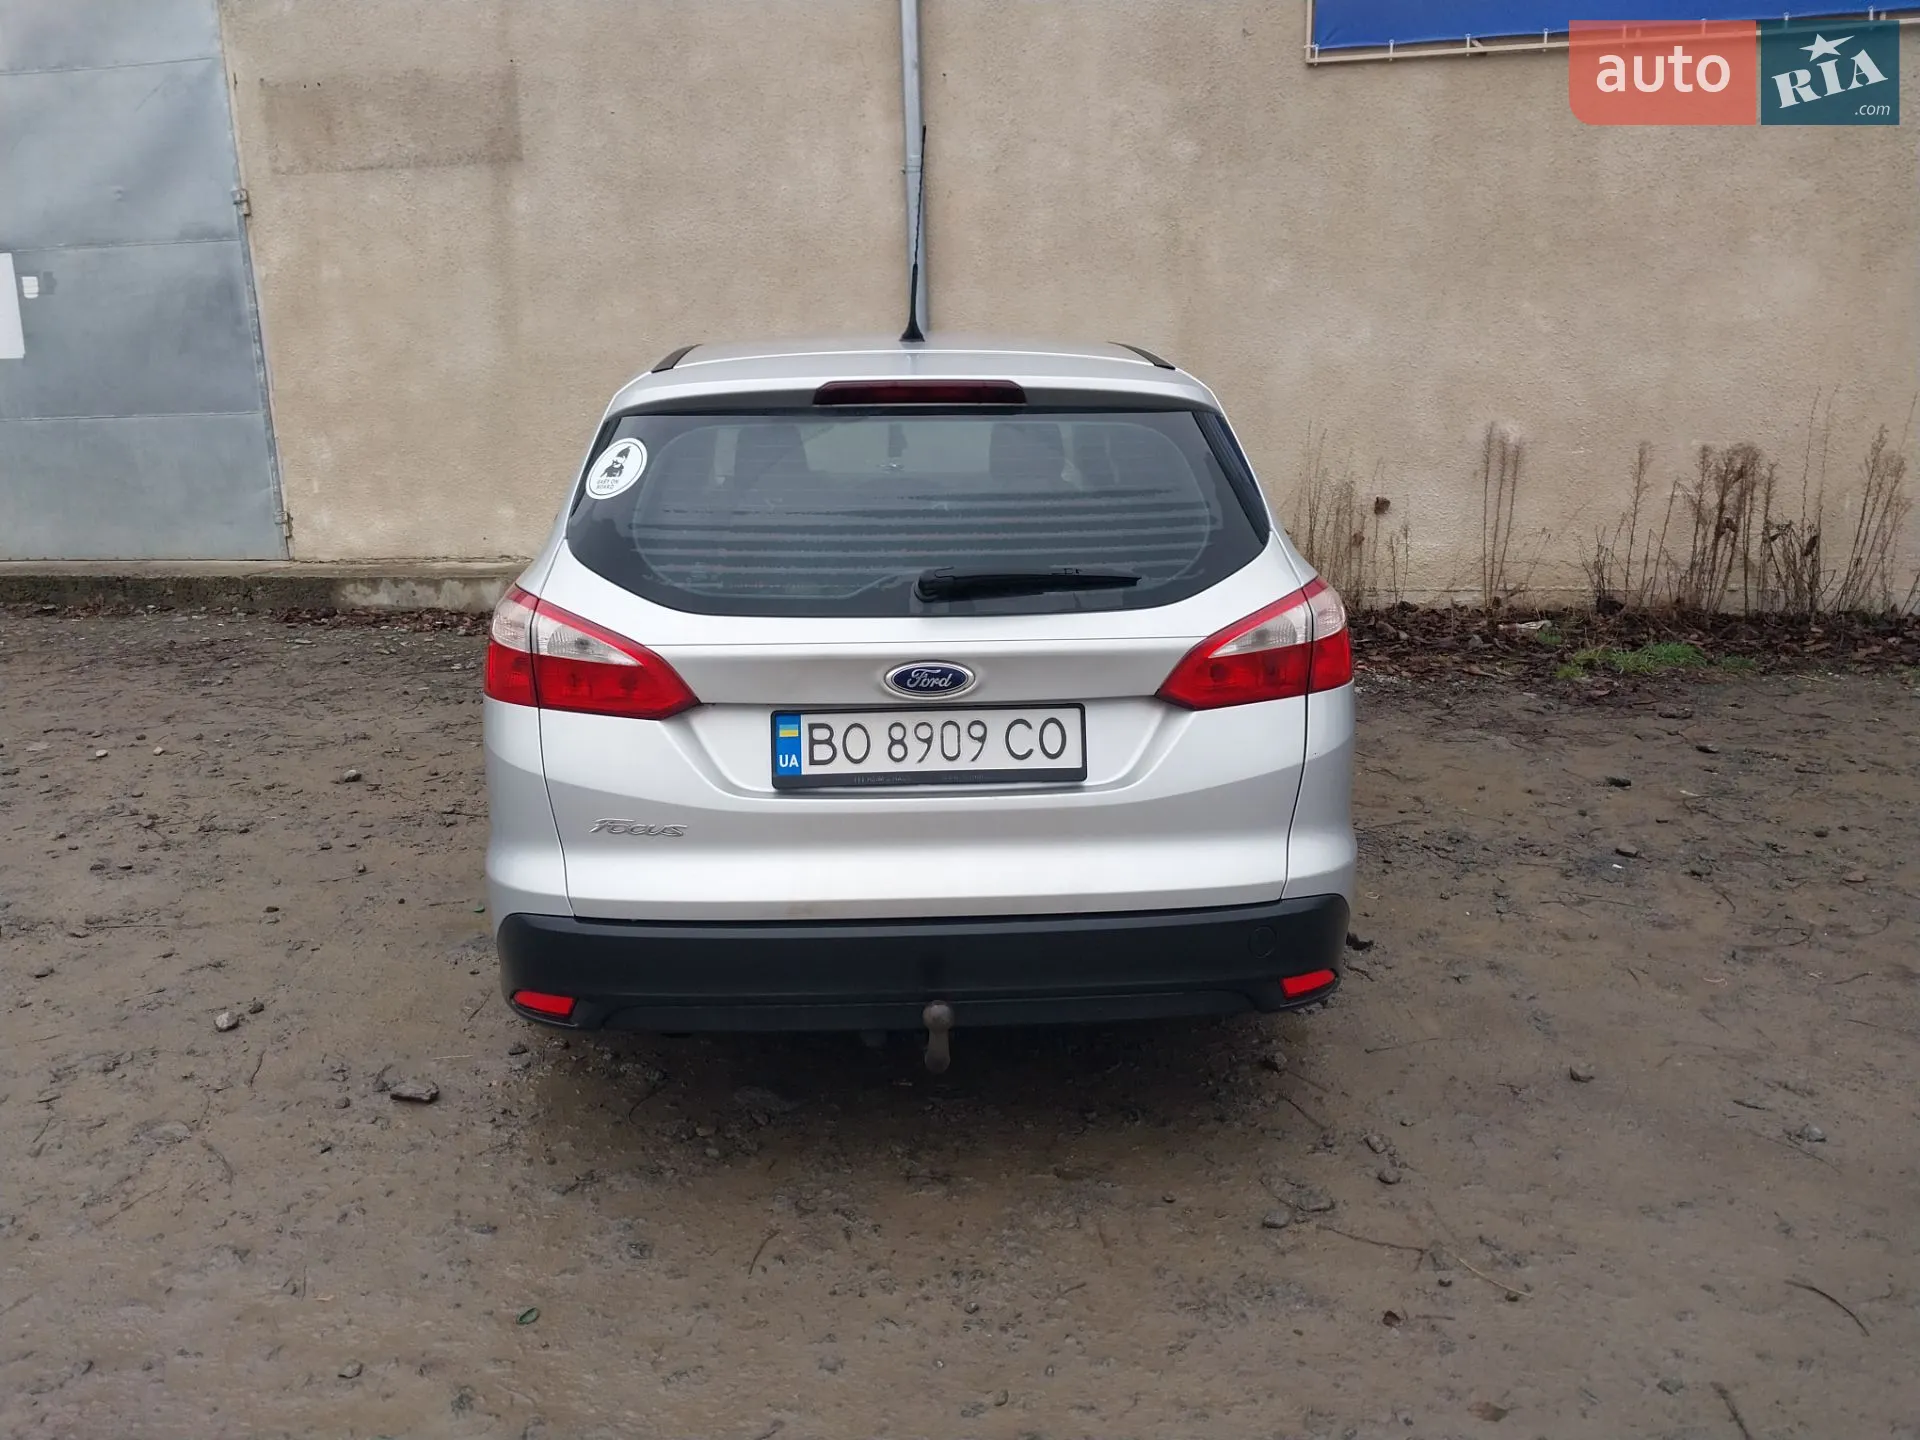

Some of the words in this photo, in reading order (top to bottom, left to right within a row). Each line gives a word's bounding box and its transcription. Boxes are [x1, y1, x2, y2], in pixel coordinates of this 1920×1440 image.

[906, 668, 953, 688] Ford
[808, 722, 871, 766] BO
[887, 719, 988, 764] 8909
[1004, 716, 1067, 761] CO
[779, 754, 799, 768] UA
